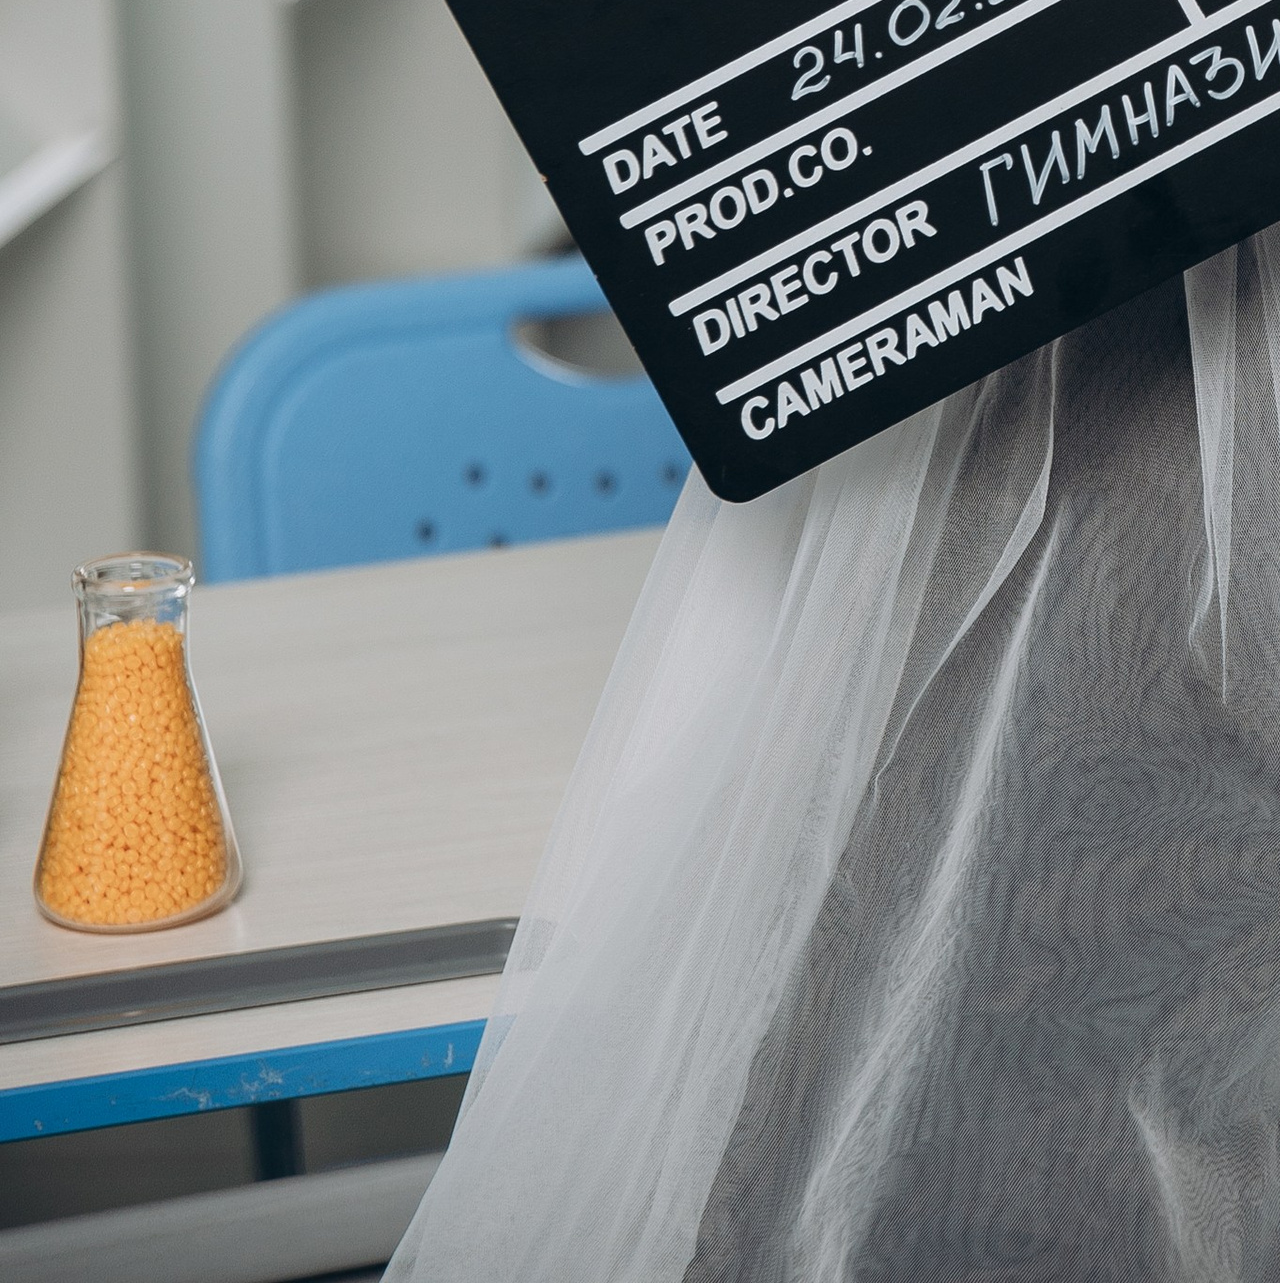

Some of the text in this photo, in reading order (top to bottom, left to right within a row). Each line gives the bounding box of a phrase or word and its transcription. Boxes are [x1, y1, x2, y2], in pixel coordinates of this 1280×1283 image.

[602, 99, 729, 195] DATE
[644, 127, 873, 267] PROD.CO.
[692, 199, 938, 357] DIRECTOR
[740, 256, 1034, 441] CAMERAMAN
